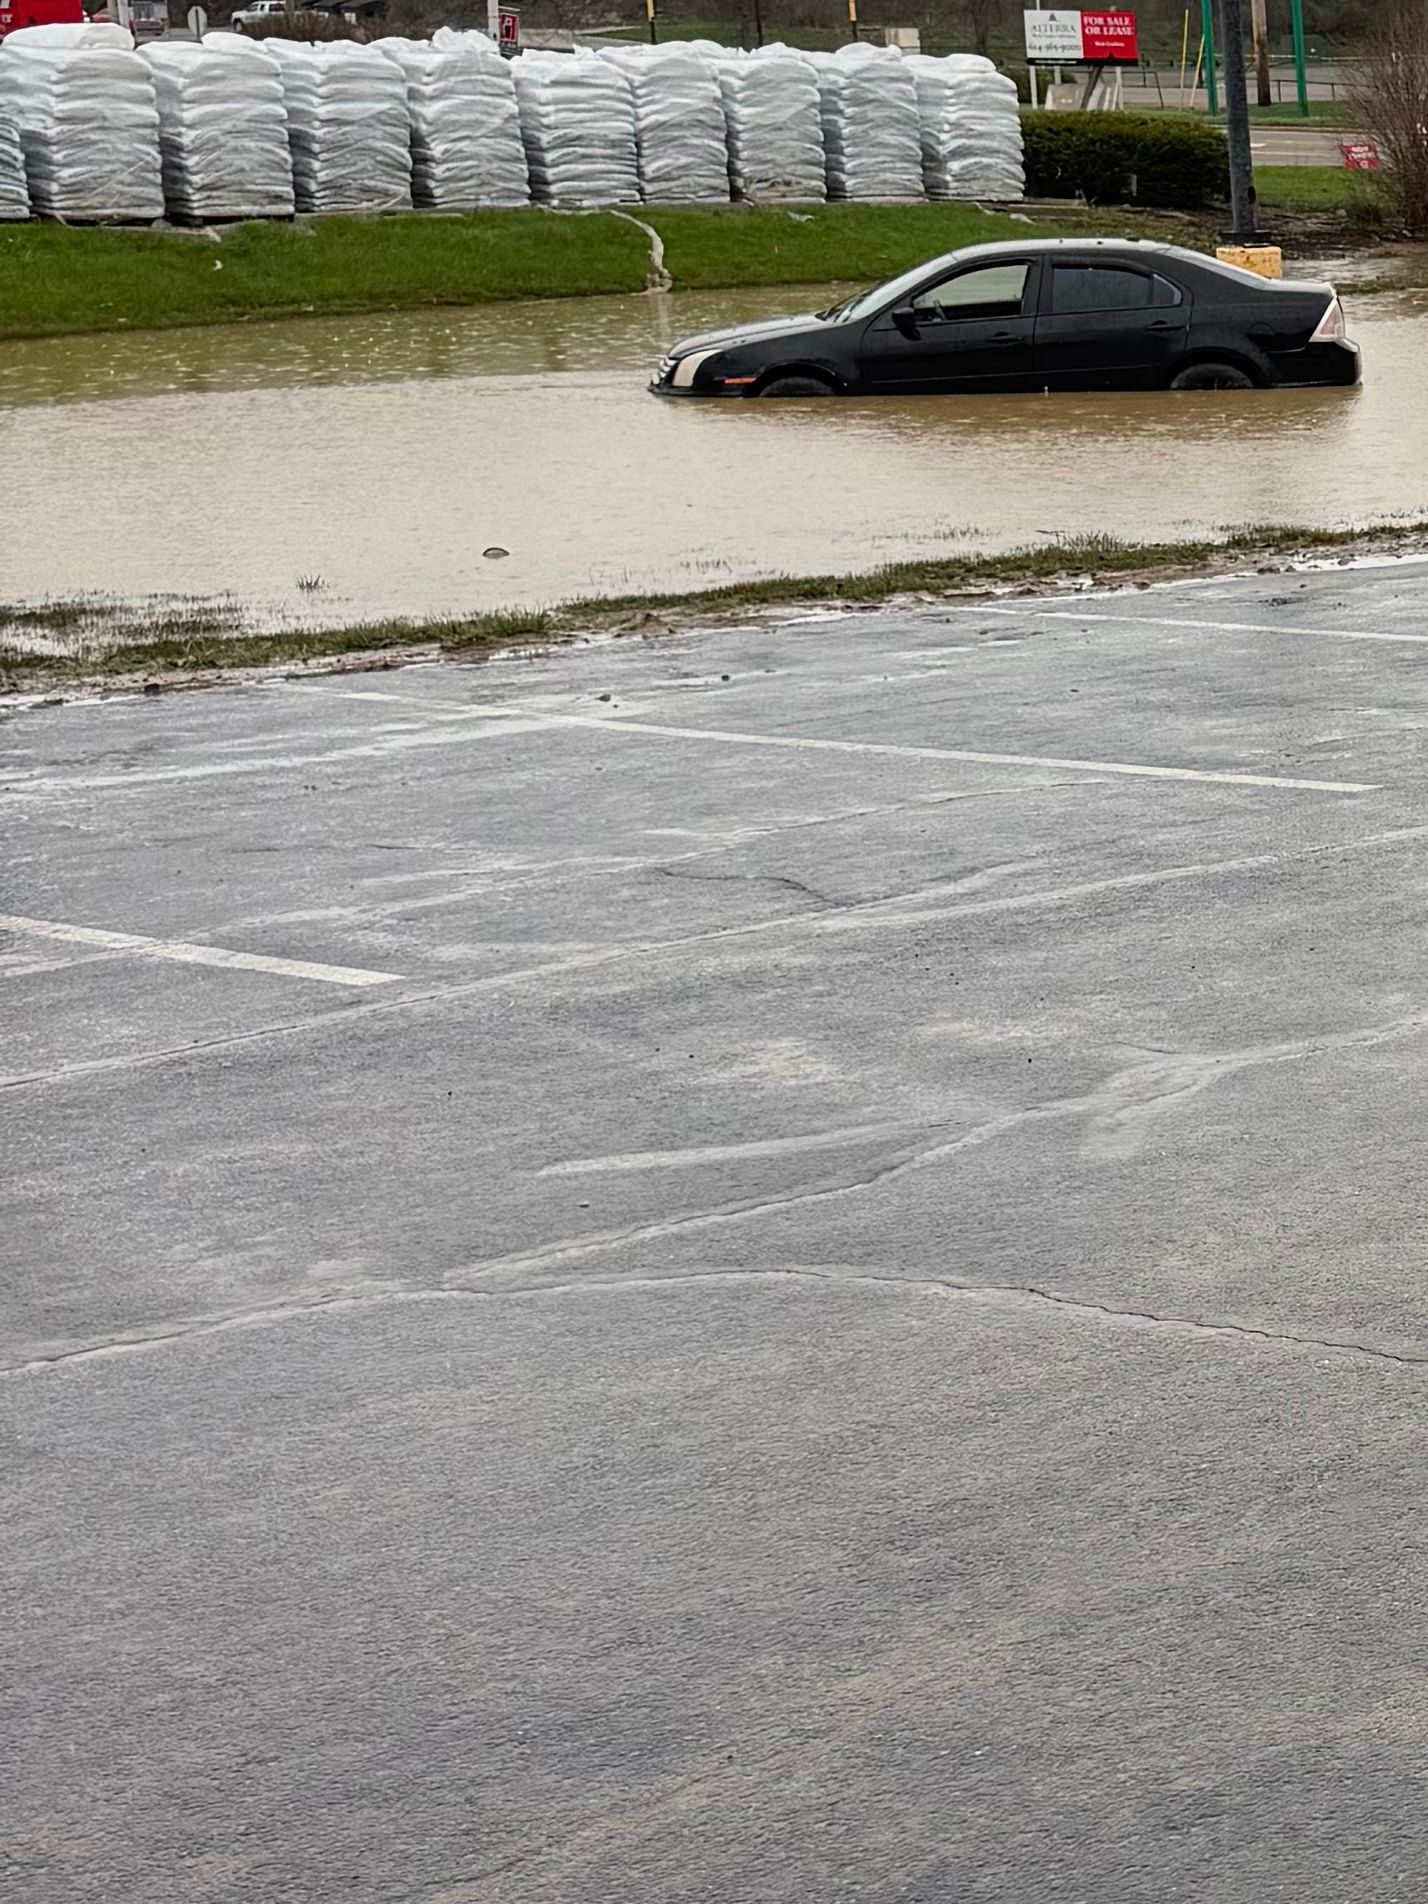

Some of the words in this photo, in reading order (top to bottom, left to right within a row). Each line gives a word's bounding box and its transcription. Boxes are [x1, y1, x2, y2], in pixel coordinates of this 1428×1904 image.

[1083, 16, 1104, 26] FOR
[1107, 16, 1131, 26] SALE
[1085, 26, 1102, 36] OR
[1103, 27, 1134, 36] LEASE
